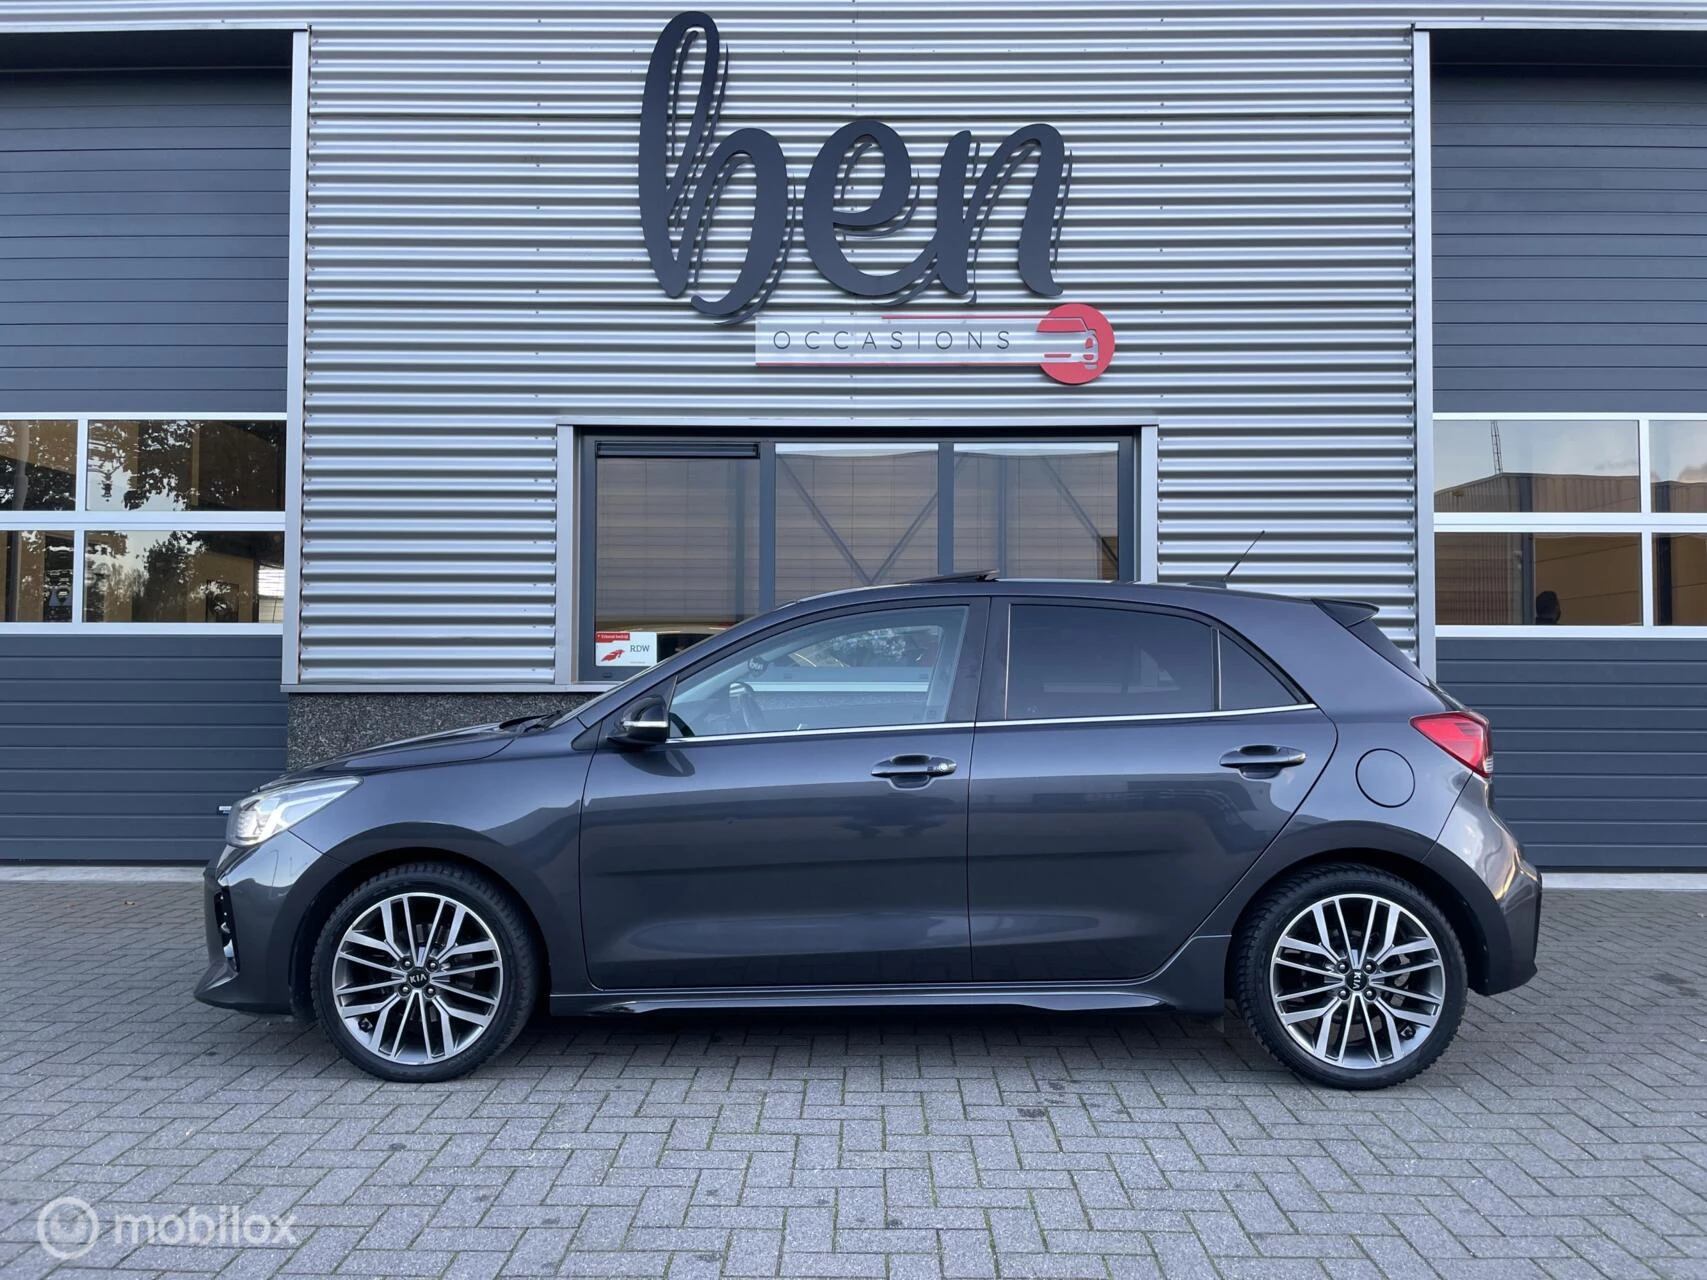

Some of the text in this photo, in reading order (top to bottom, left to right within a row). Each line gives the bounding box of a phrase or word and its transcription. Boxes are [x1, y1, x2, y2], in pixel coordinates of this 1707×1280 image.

[639, 11, 1068, 322] ben
[773, 330, 1010, 350] OCCASIONS
[630, 645, 650, 653] RDW
[410, 974, 427, 983] KIA
[1353, 972, 1361, 989] KIA
